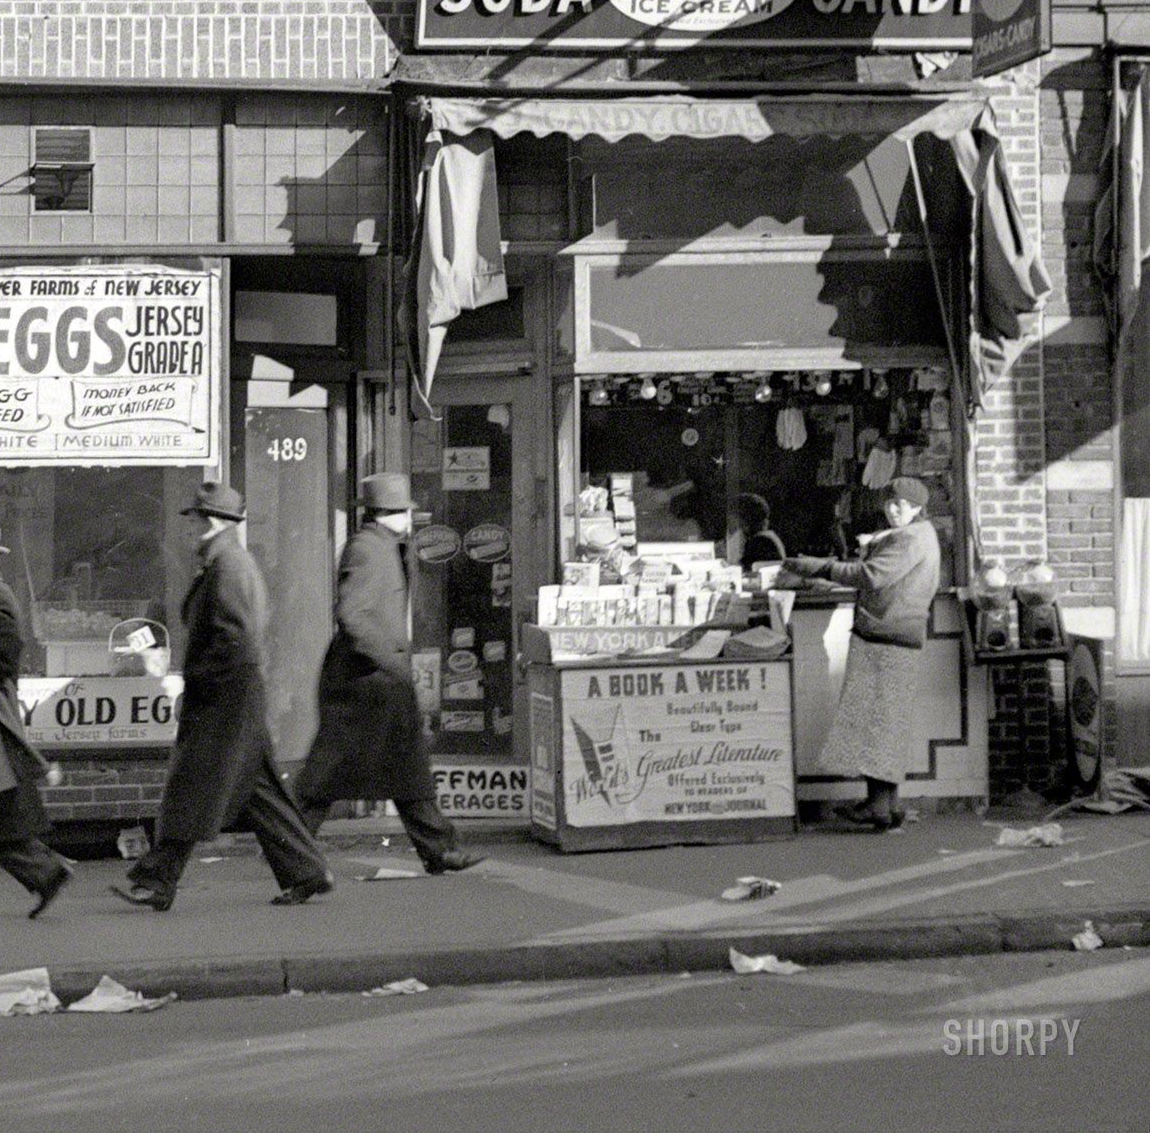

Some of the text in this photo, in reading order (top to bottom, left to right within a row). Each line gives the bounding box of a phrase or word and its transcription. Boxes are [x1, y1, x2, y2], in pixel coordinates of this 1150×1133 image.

[31, 279, 79, 297] FARMS
[105, 279, 141, 297] NEW
[144, 279, 201, 297] JERSEY
[125, 305, 204, 337] JERSEY
[128, 342, 203, 376] GRADE A
[84, 381, 176, 400] MONEY BACK
[81, 398, 176, 417] IF NOT SATISFIED
[62, 435, 182, 448] MEDIUM WHITE
[267, 437, 307, 461] 489
[470, 529, 505, 541] CANDY
[550, 631, 590, 649] NEW
[593, 631, 649, 649] YORK
[588, 675, 603, 698] A
[609, 672, 664, 697] BOOK
[675, 671, 688, 694] A
[697, 669, 750, 693] WEEK
[55, 697, 116, 727] OLD
[131, 695, 172, 725] EG
[108, 727, 148, 740] farms
[639, 729, 661, 742] The
[636, 746, 703, 781] Greatest
[704, 741, 782, 766] Literature
[433, 770, 527, 790] FFMAN
[668, 772, 765, 786] Offered Exclusively
[440, 793, 524, 810] ERAGES
[665, 798, 767, 815] NEW YORK JOURNAL
